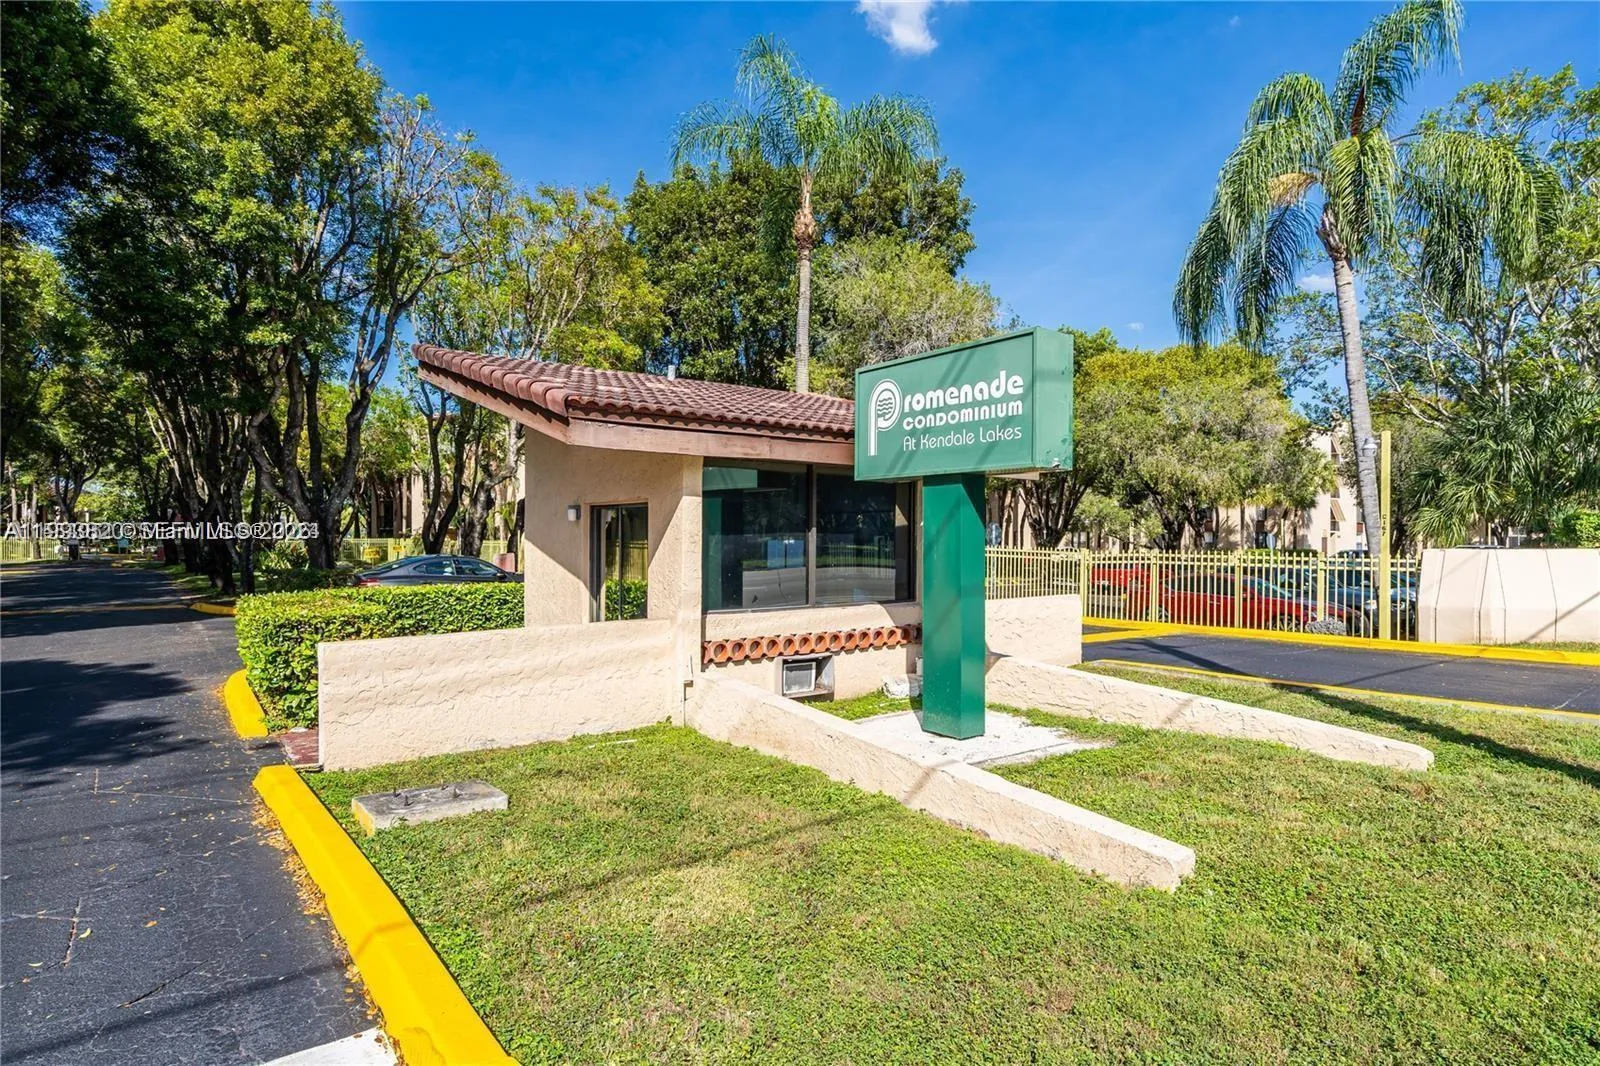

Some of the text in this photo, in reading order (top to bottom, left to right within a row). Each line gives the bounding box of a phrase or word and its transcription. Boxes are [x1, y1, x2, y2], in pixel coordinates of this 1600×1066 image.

[868, 370, 1024, 456] Promenade
[903, 425, 1022, 451] At Kendale Lakes
